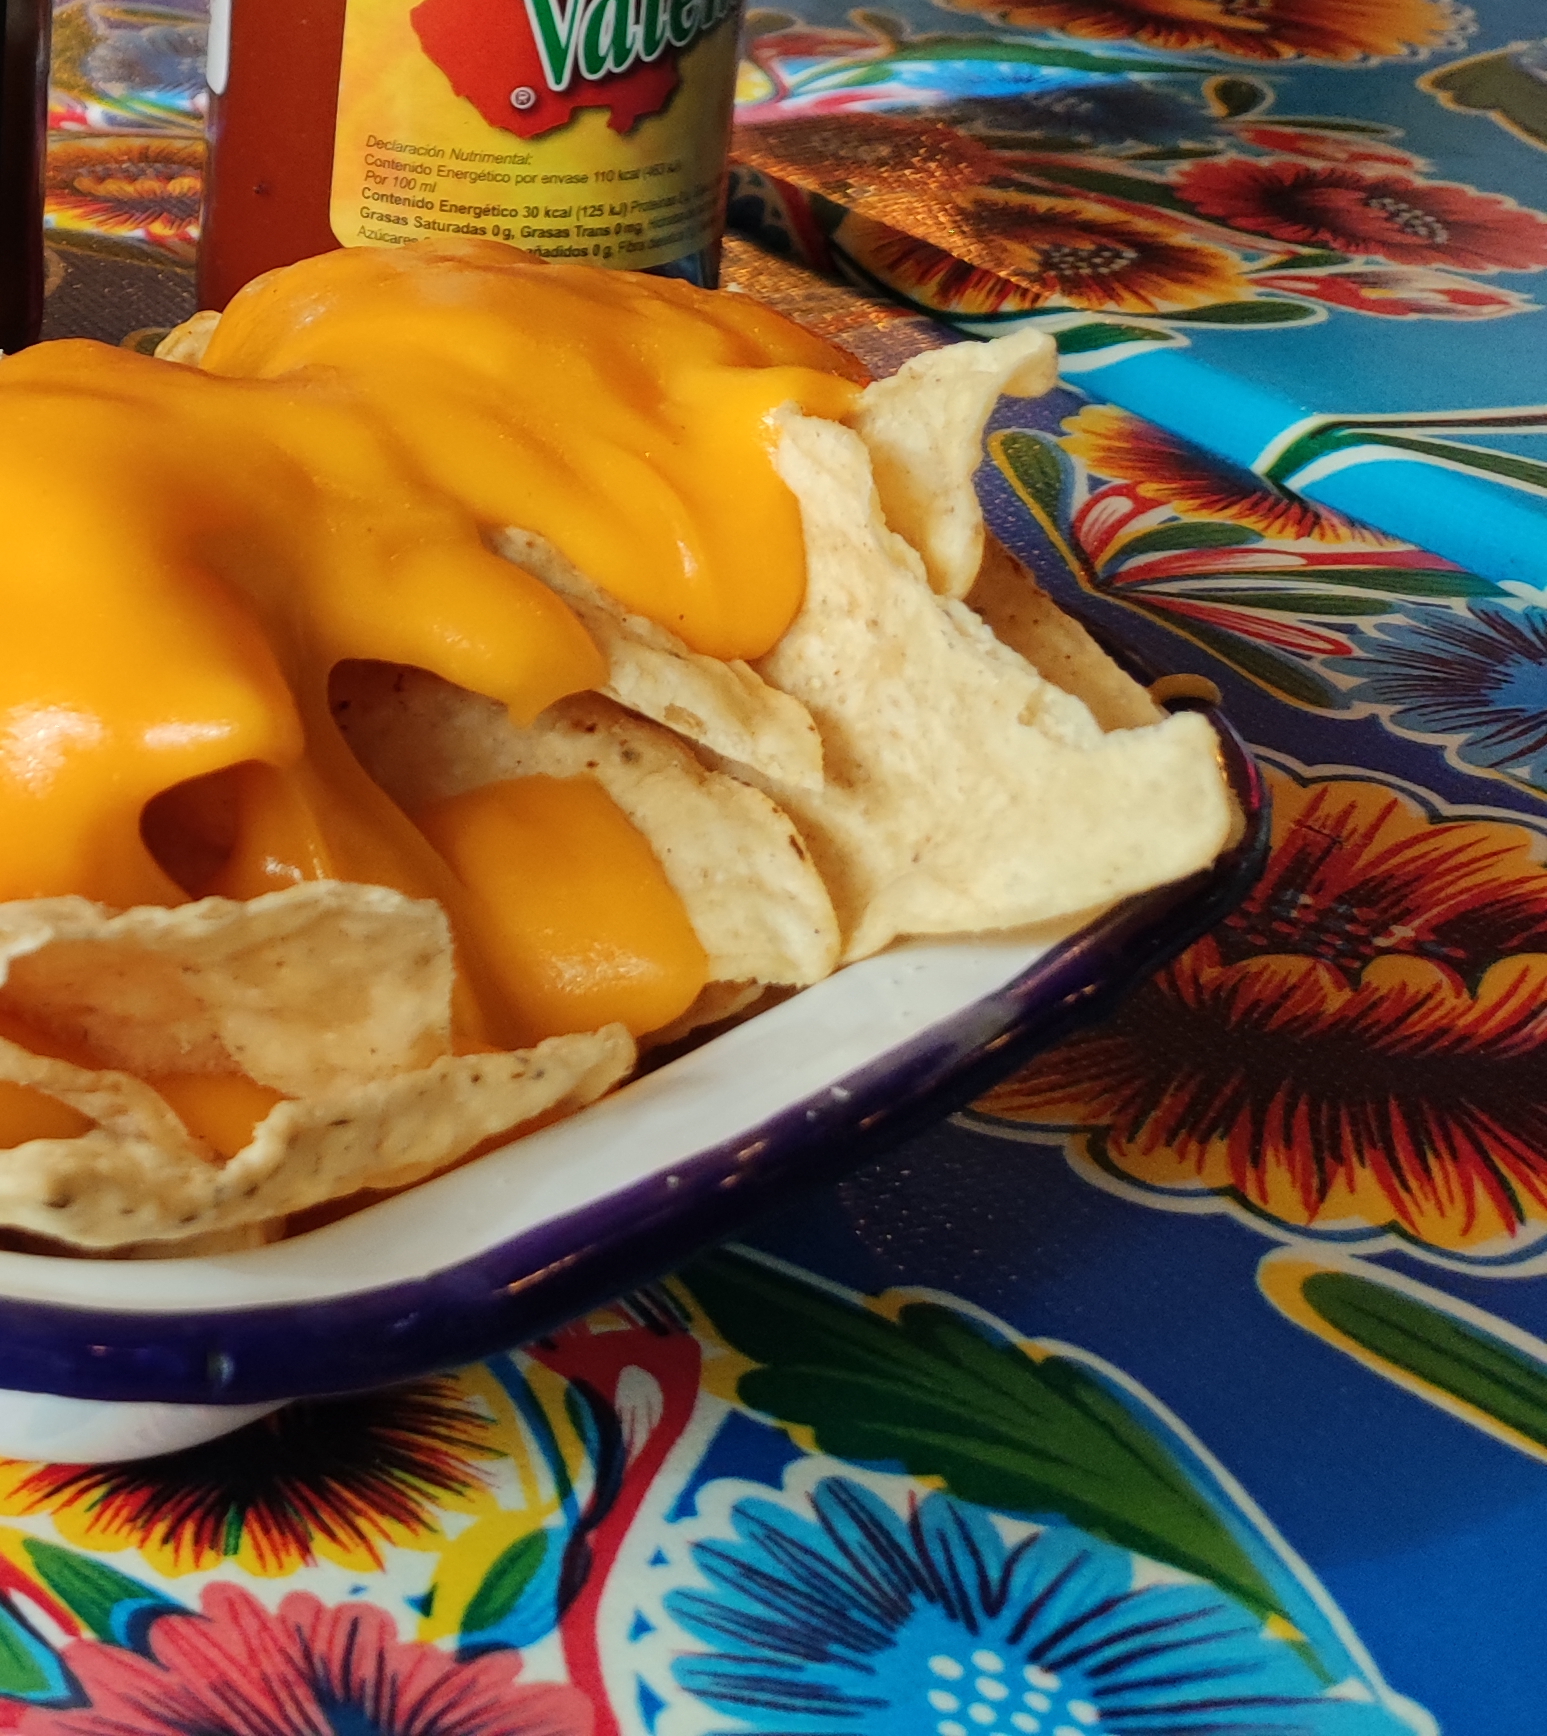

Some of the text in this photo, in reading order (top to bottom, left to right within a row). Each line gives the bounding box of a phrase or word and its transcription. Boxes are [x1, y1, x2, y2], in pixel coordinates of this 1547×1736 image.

[365, 134, 446, 158] Declaración
[364, 153, 433, 176] Contenido
[436, 164, 511, 185] Energético
[514, 173, 539, 187] por
[541, 173, 589, 184] envase
[593, 169, 616, 183] 110
[364, 169, 438, 194] Por 100 ml
[361, 186, 435, 210] Contenido
[438, 199, 519, 219] Energético
[522, 205, 540, 219] 30
[544, 205, 573, 219] kcal
[576, 204, 605, 222] (125
[359, 206, 409, 226] Grasas
[413, 215, 487, 236] Saturadas
[520, 225, 571, 239] Grasas
[574, 224, 611, 238] Trans
